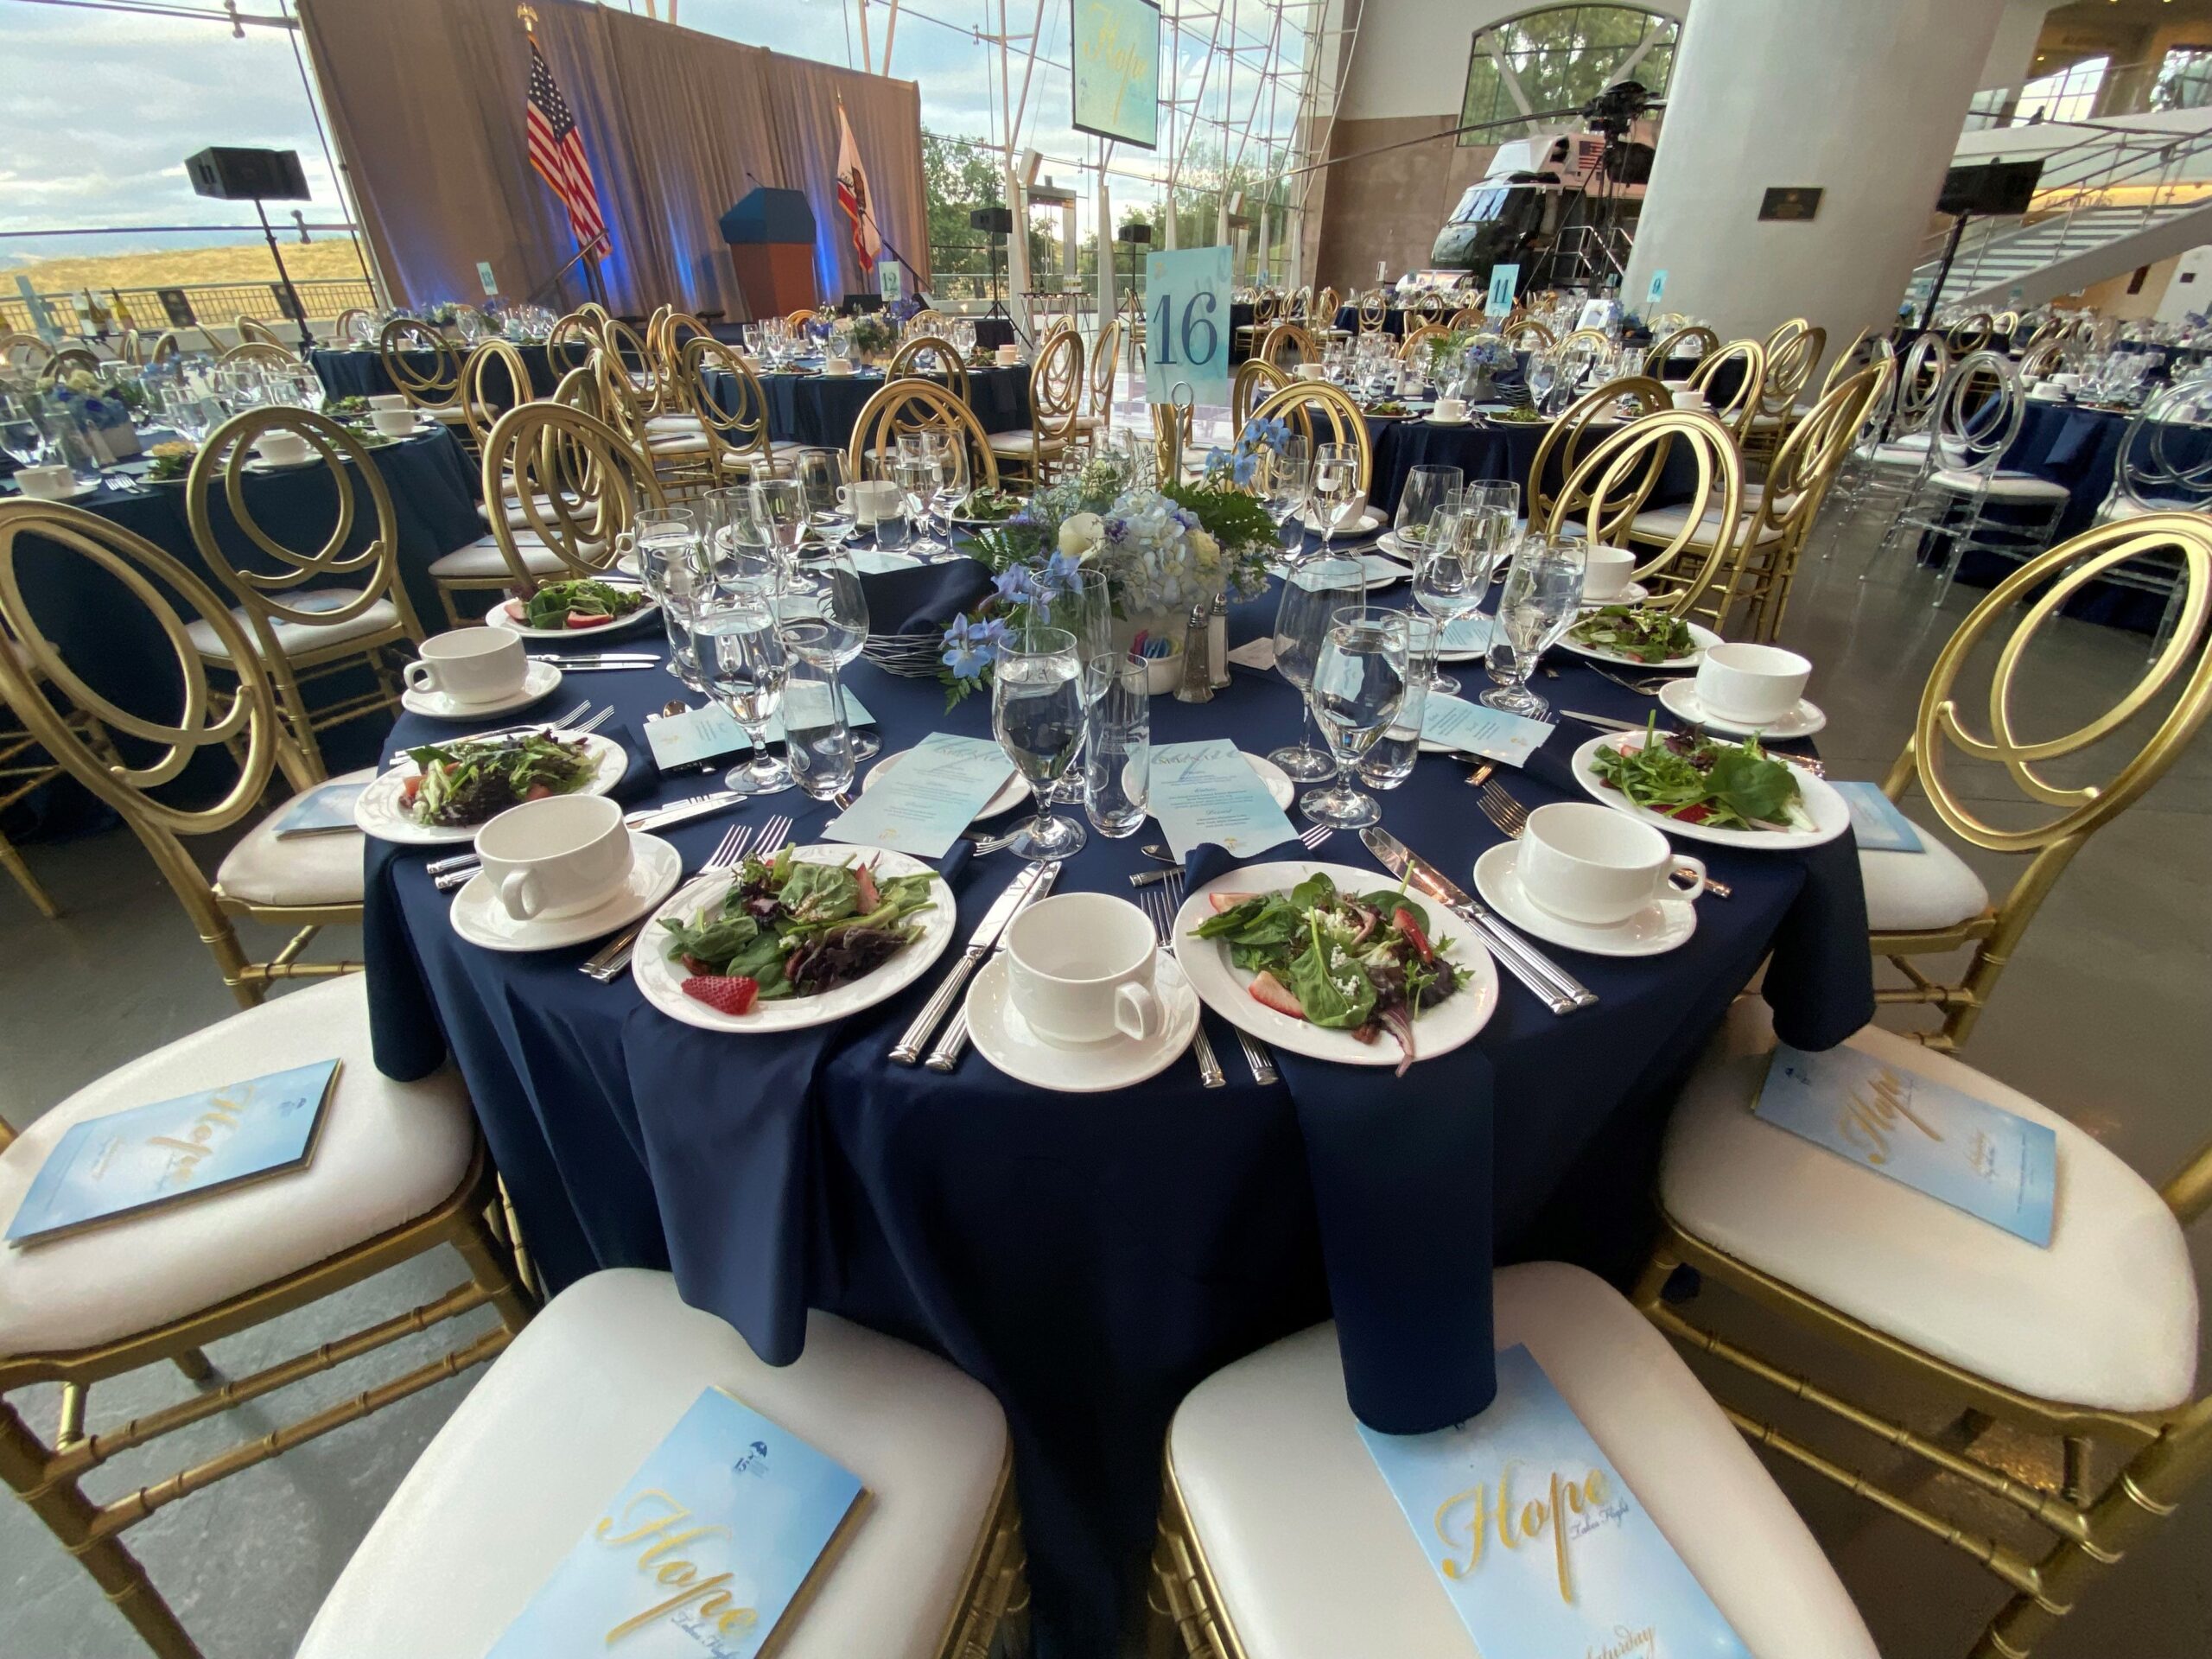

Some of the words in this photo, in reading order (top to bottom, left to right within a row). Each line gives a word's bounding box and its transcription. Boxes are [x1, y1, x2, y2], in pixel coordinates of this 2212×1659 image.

[1083, 3, 1147, 124] Hope
[883, 271, 898, 291] 12
[1154, 291, 1217, 365] 16
[1491, 279, 1509, 303] 11
[146, 1085, 256, 1183] Hope
[1839, 1067, 1944, 1165] Hope
[597, 1489, 758, 1643] Hope
[1434, 1459, 1610, 1605] Hope
